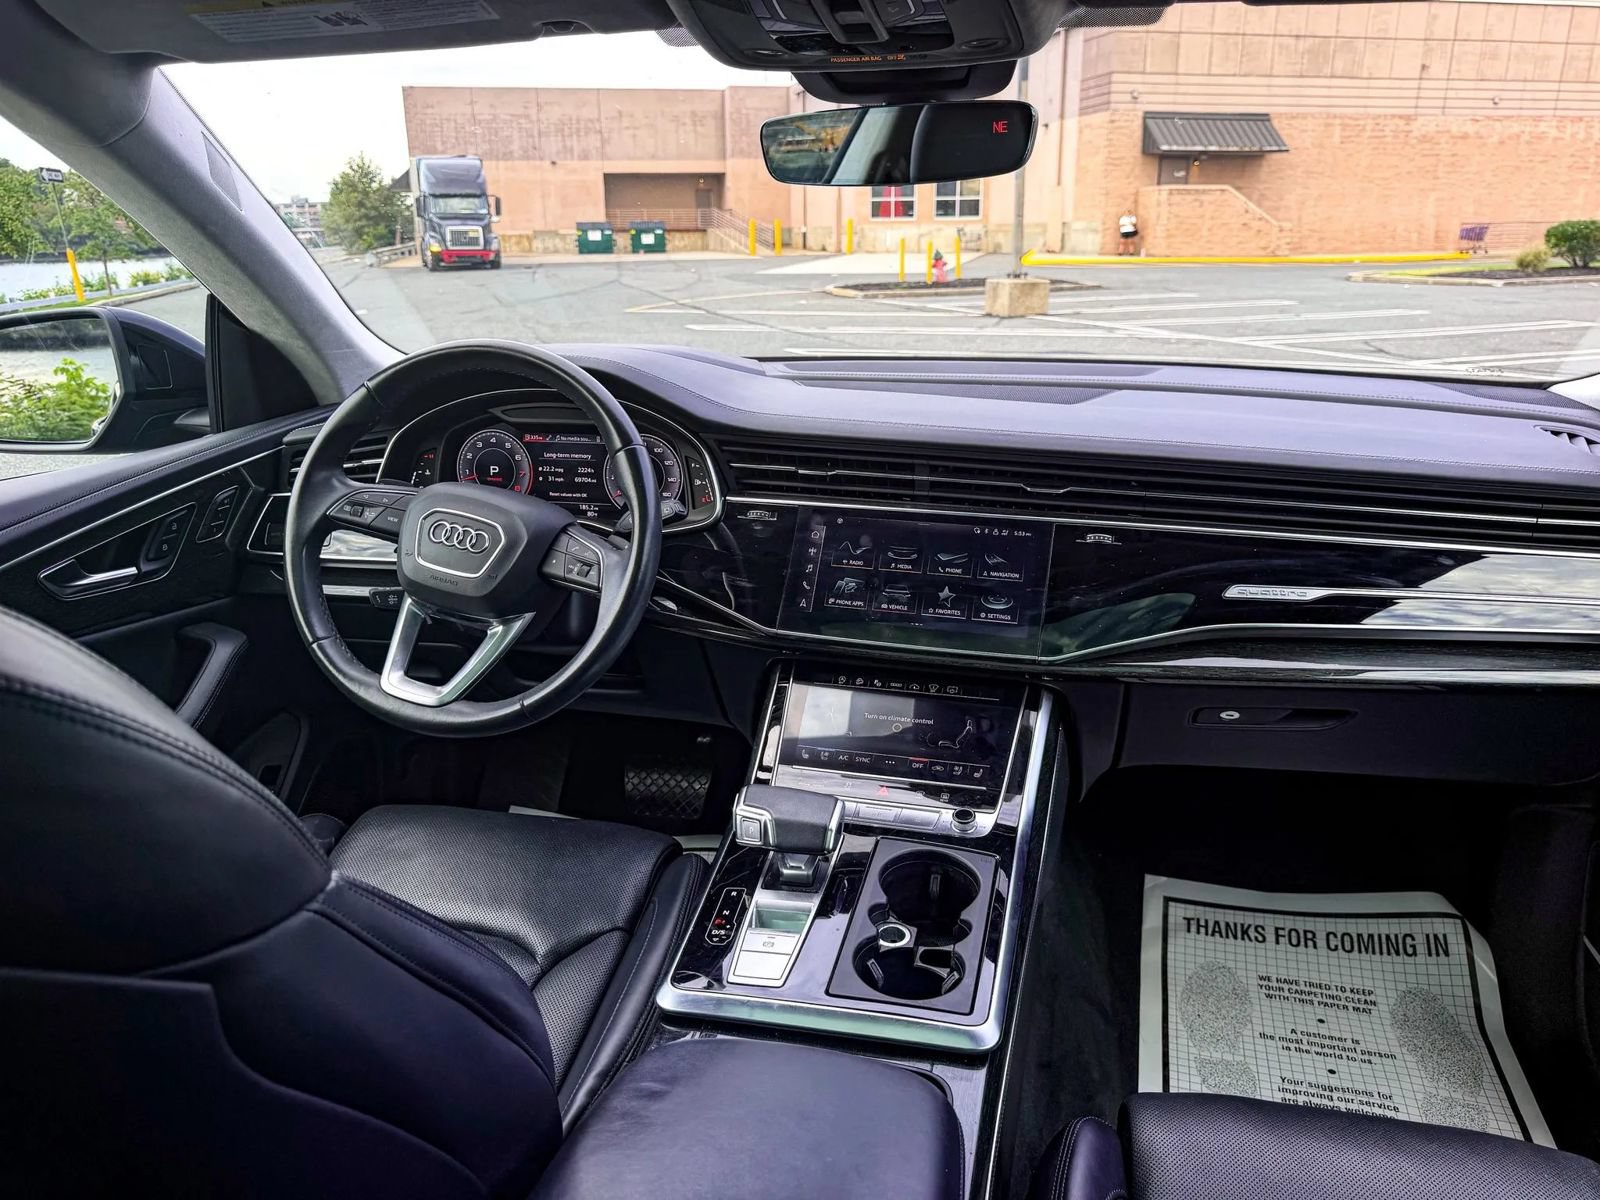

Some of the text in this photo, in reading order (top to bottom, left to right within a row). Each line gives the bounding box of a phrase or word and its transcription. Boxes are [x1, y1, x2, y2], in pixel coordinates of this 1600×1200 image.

[992, 121, 1008, 134] NE
[489, 465, 499, 476] P
[1237, 588, 1308, 597] quattro
[836, 597, 864, 607] PHONE APPS
[888, 603, 908, 611] VEHICLE
[935, 608, 961, 616] FAVORITES
[855, 756, 871, 764] SYNC
[1183, 916, 1450, 958] THANKS FOR COMING IN
[1257, 974, 1374, 997] WE HAVE TRIED TO KEEP
[1258, 983, 1377, 1007] YOUR CARPETING CLEAN
[1264, 992, 1373, 1015] WITH THIS PAPER MAT
[1300, 1030, 1347, 1043] customer
[1351, 1037, 1361, 1045] is
[1259, 1032, 1397, 1060] the most important person
[1281, 1044, 1377, 1066] in the world to us.
[1280, 1075, 1393, 1101] Your suggestions for
[1277, 1085, 1400, 1113] improving our service
[1280, 1096, 1299, 1105] are
[1302, 1098, 1341, 1111] always
